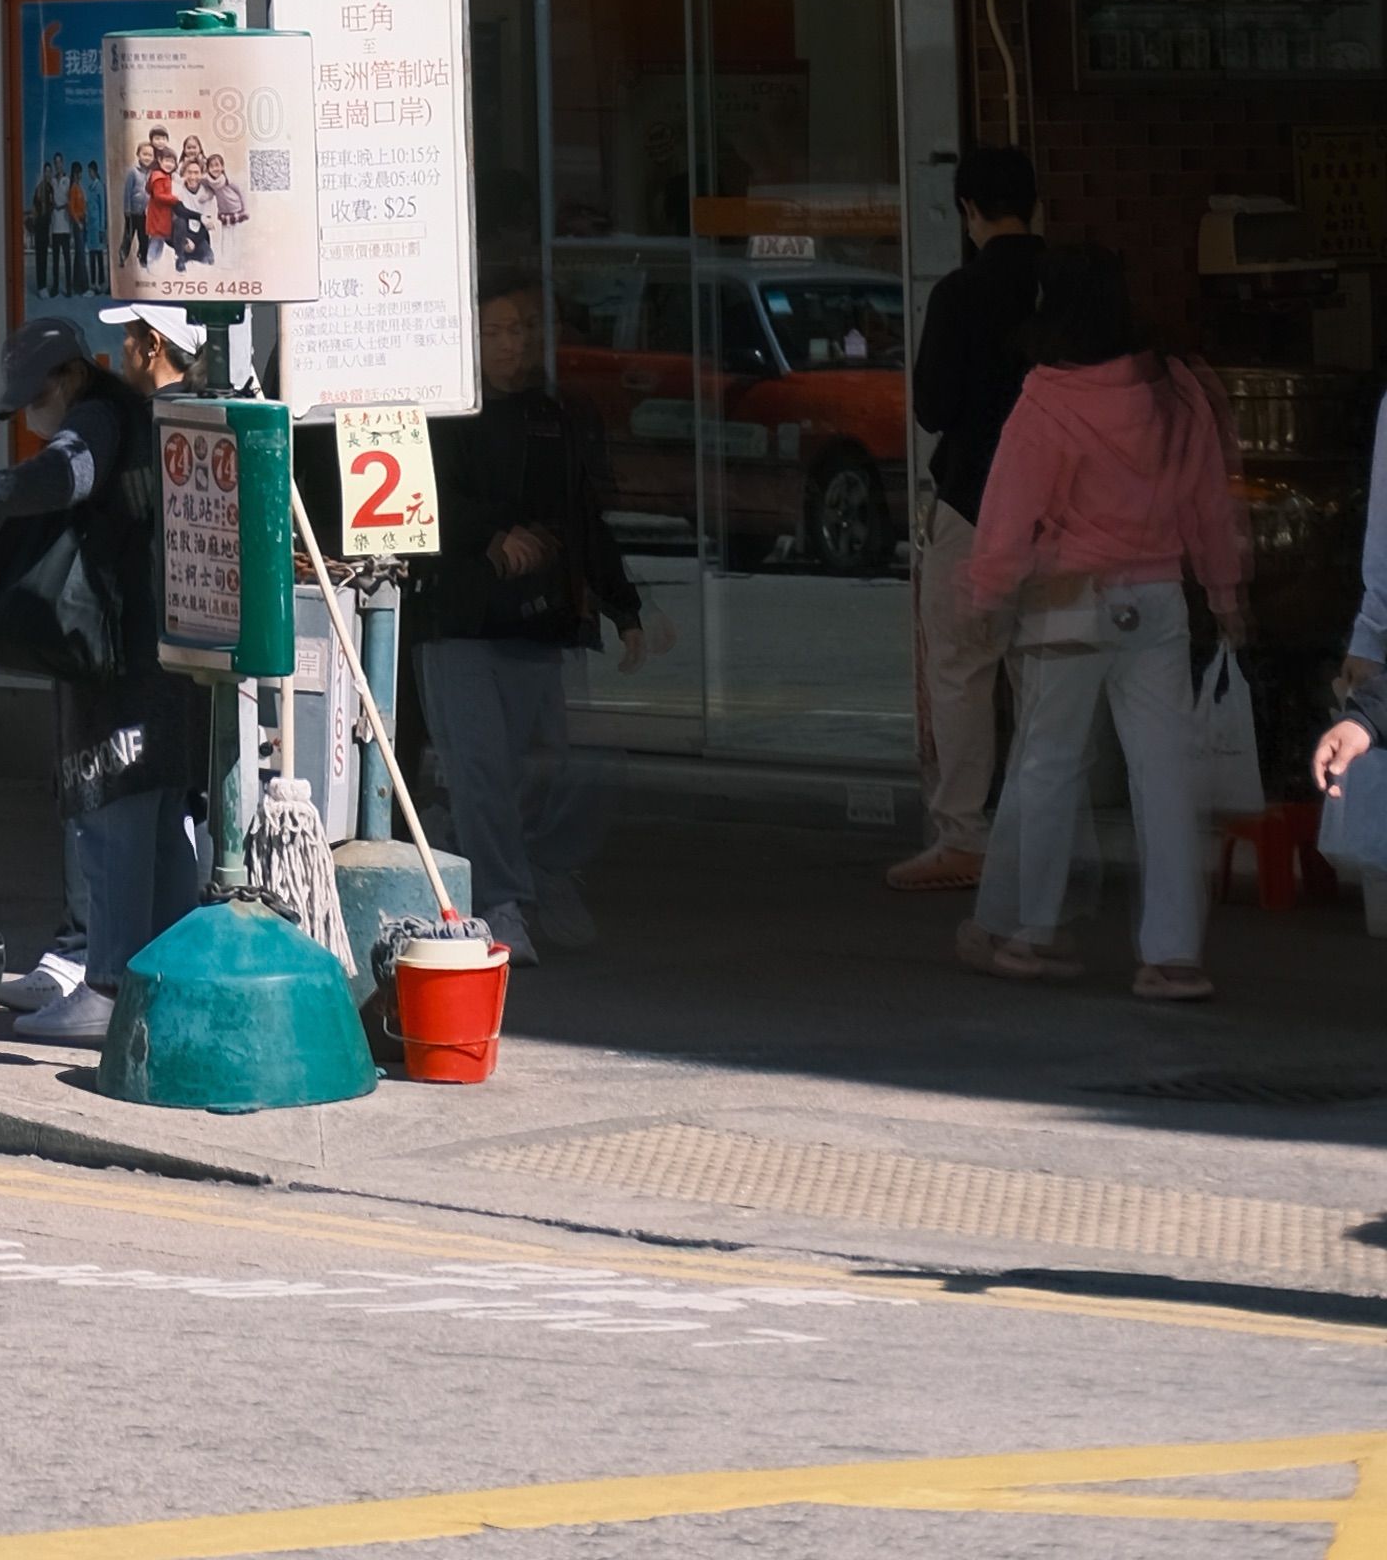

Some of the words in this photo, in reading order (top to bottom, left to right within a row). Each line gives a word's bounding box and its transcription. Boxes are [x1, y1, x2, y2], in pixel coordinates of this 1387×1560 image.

[341, 1, 394, 33] 旺角
[362, 37, 378, 55] 至
[212, 86, 284, 143] 80
[383, 195, 417, 220] $25
[161, 281, 209, 296] 3756
[214, 280, 263, 296] 4488
[378, 269, 403, 297] $2
[350, 450, 405, 529] 2
[404, 492, 434, 526] 元
[166, 492, 213, 522] 九龍站
